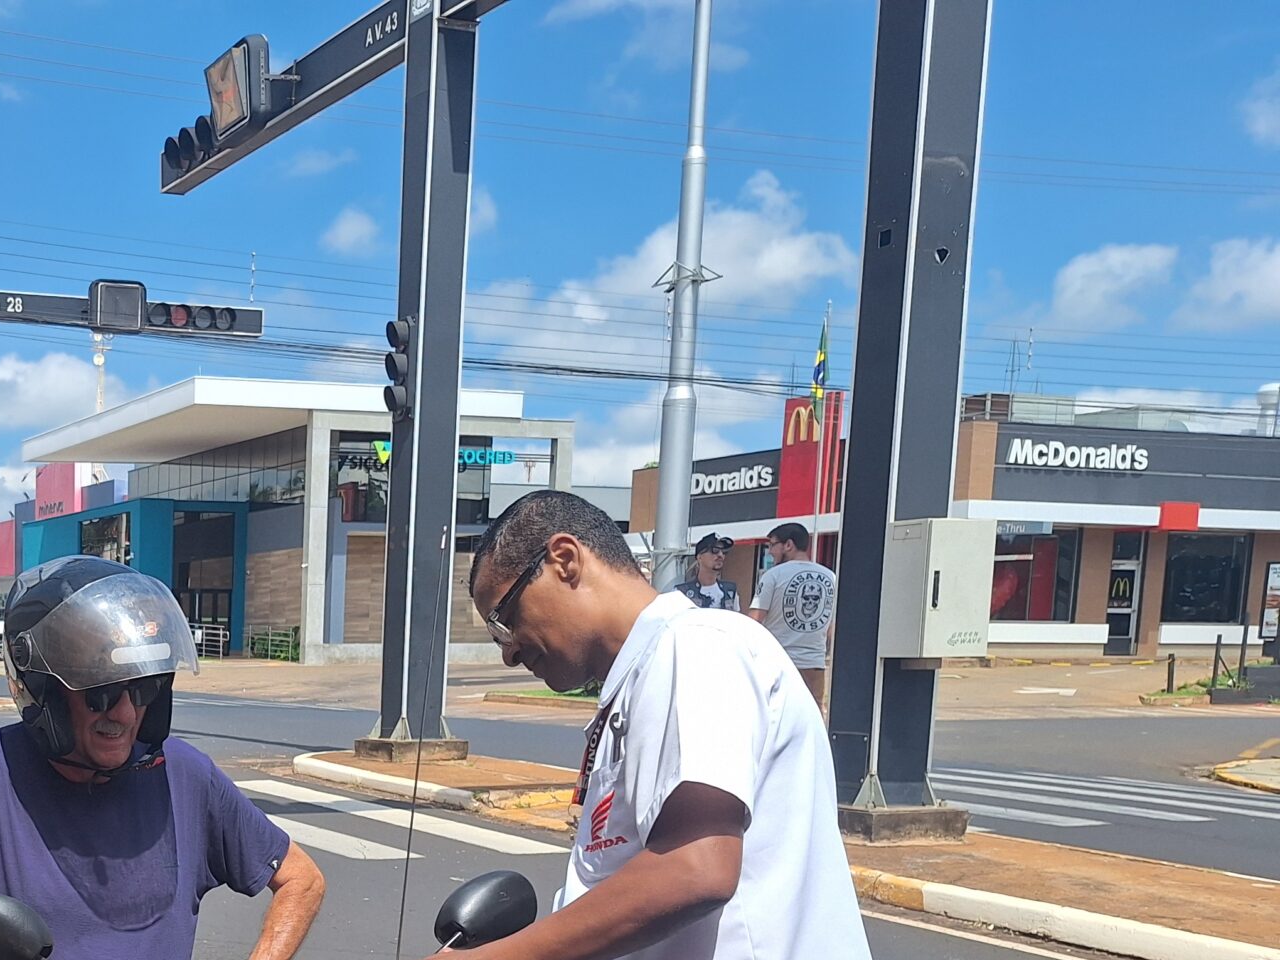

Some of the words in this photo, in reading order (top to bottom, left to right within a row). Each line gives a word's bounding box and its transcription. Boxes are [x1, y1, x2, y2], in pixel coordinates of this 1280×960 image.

[385, 11, 398, 34] 43
[6, 297, 23, 313] 28
[1006, 438, 1148, 471] McDonald's
[691, 465, 773, 495] Donald's
[996, 522, 1025, 534] e-Thru
[787, 572, 834, 596] INSANOS
[785, 609, 830, 631] BRASIL
[584, 718, 605, 780] HOND
[584, 835, 630, 853] HONDA
